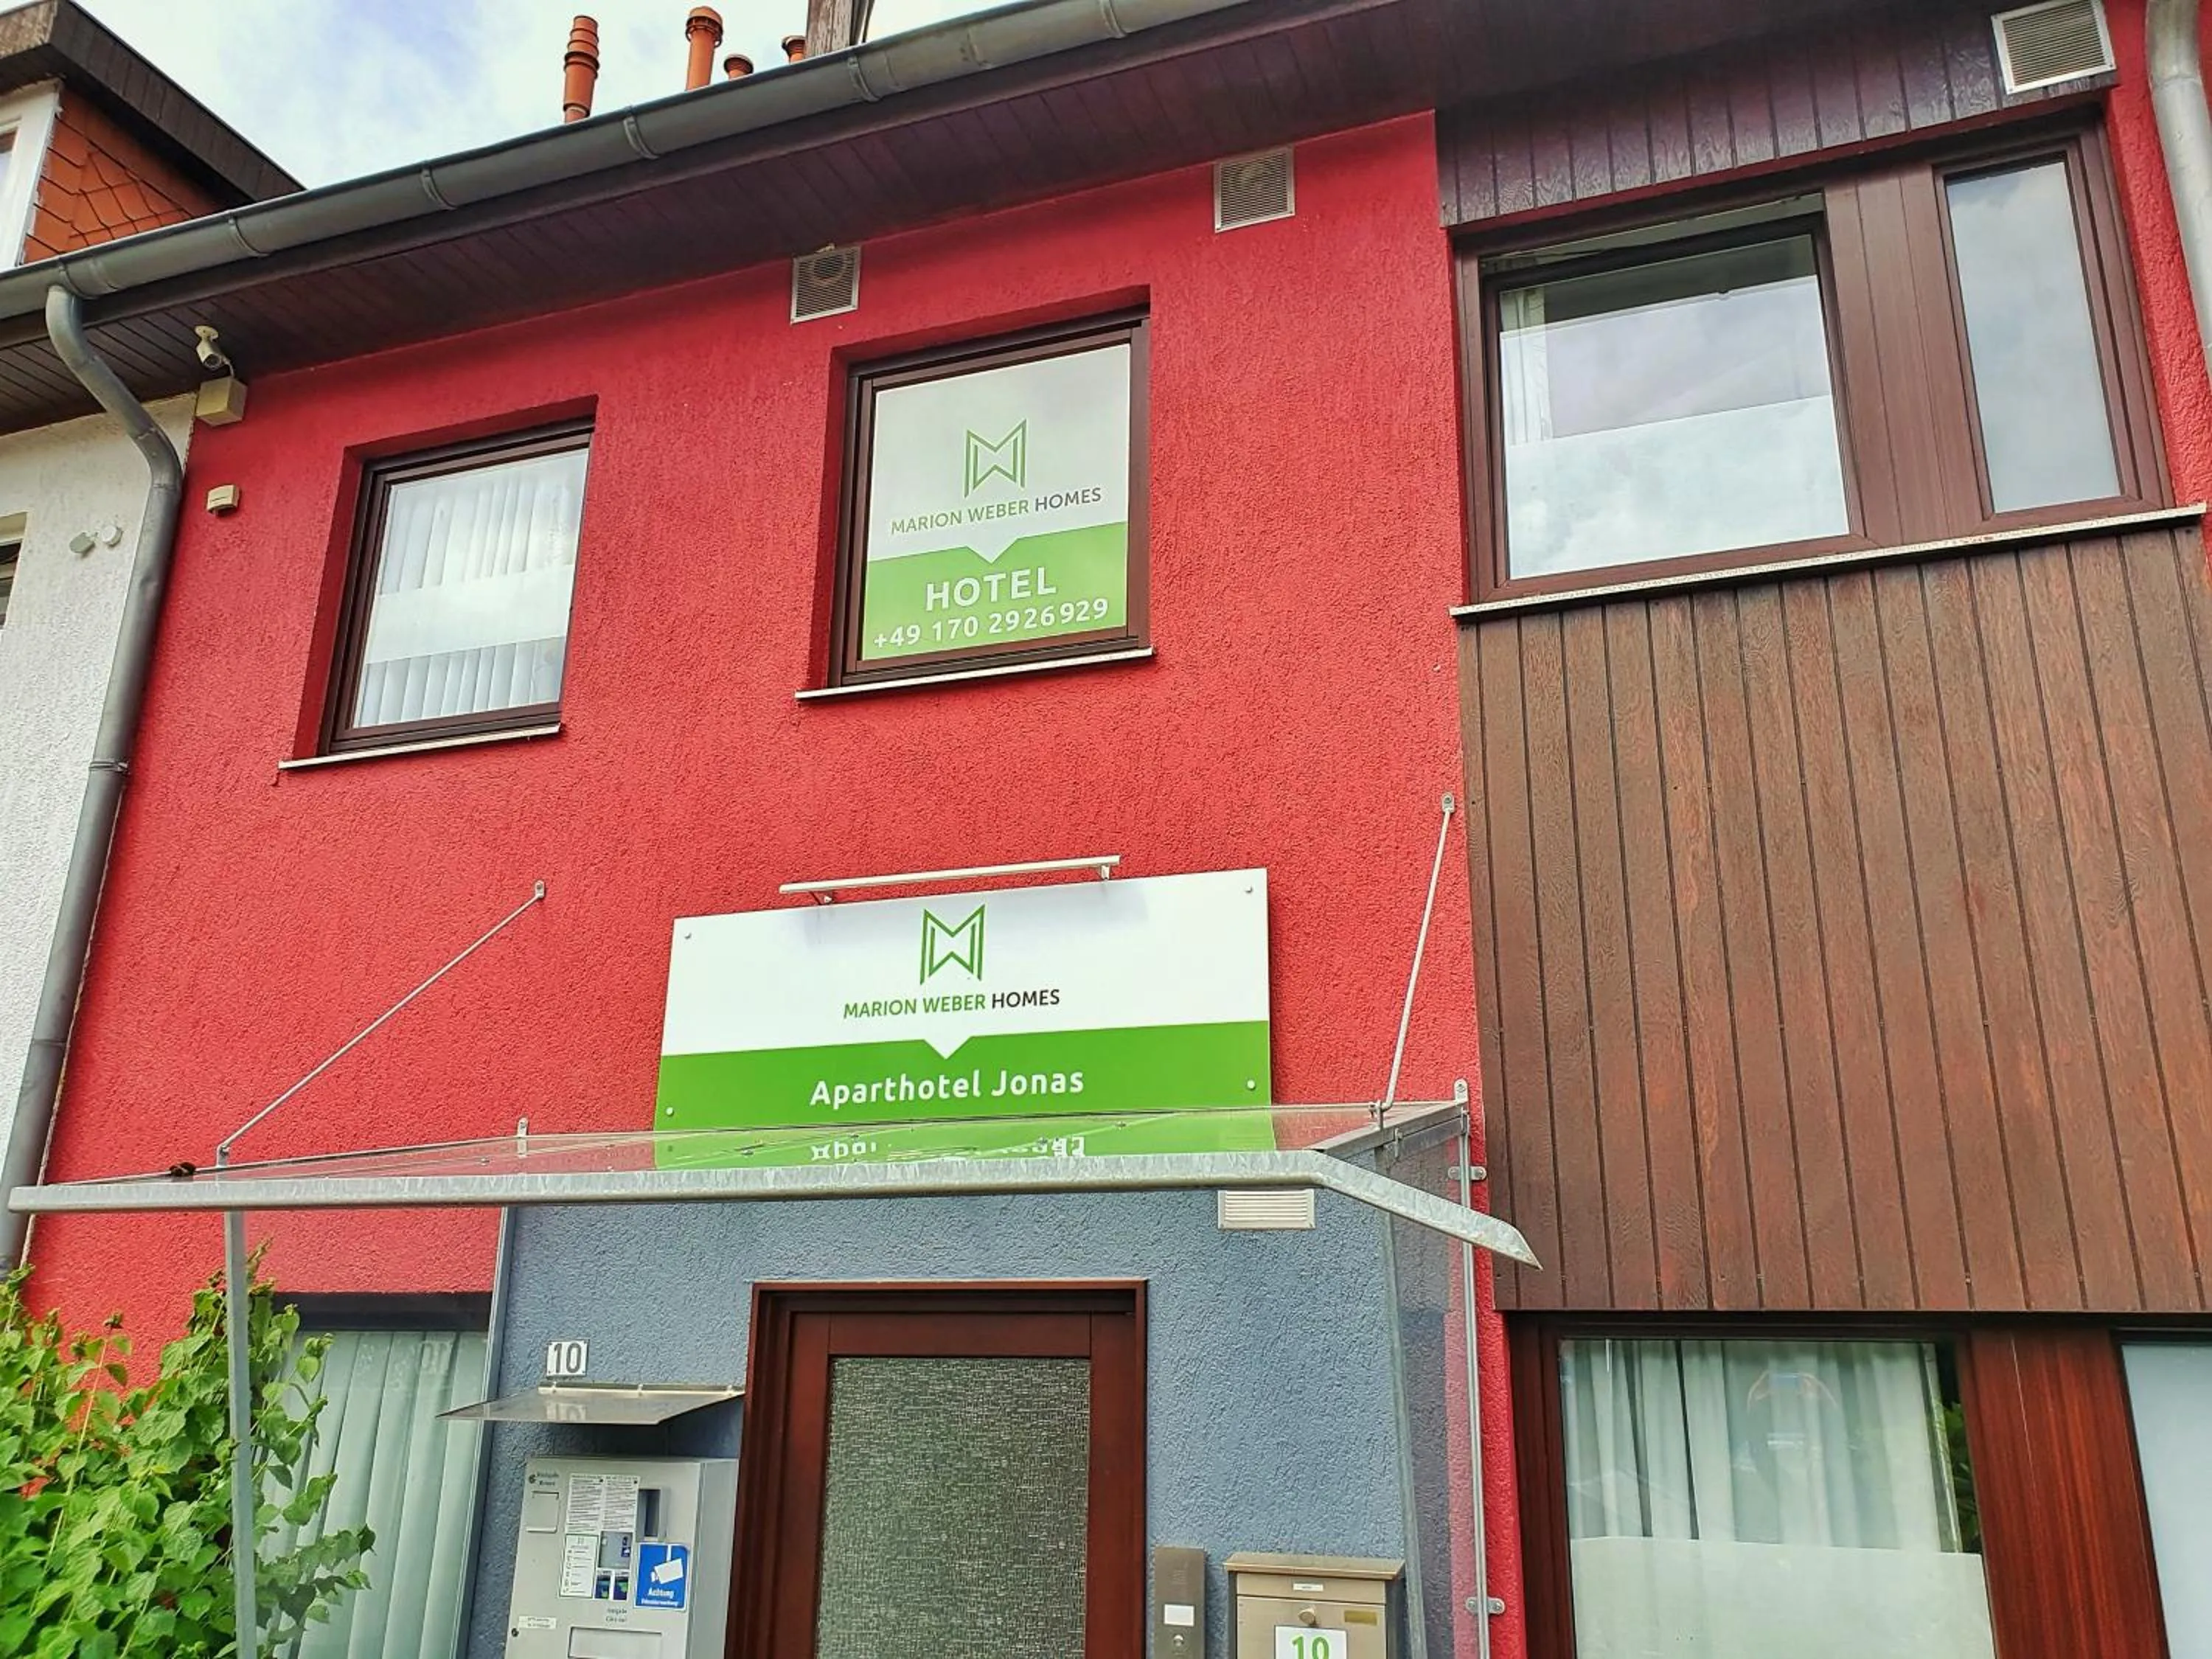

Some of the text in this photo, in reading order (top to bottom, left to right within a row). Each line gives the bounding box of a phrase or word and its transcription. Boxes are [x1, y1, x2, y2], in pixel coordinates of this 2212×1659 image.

[891, 487, 1102, 535] MARION WEBER HOMES
[926, 567, 1057, 611] HOTEL
[874, 598, 1108, 649] +49 170 2926929
[843, 989, 1060, 1019] MARION WEBER HOMES
[810, 1069, 1085, 1110] Aparthotel Jonas
[554, 1343, 582, 1373] 10
[1292, 1635, 1329, 1659] 10
